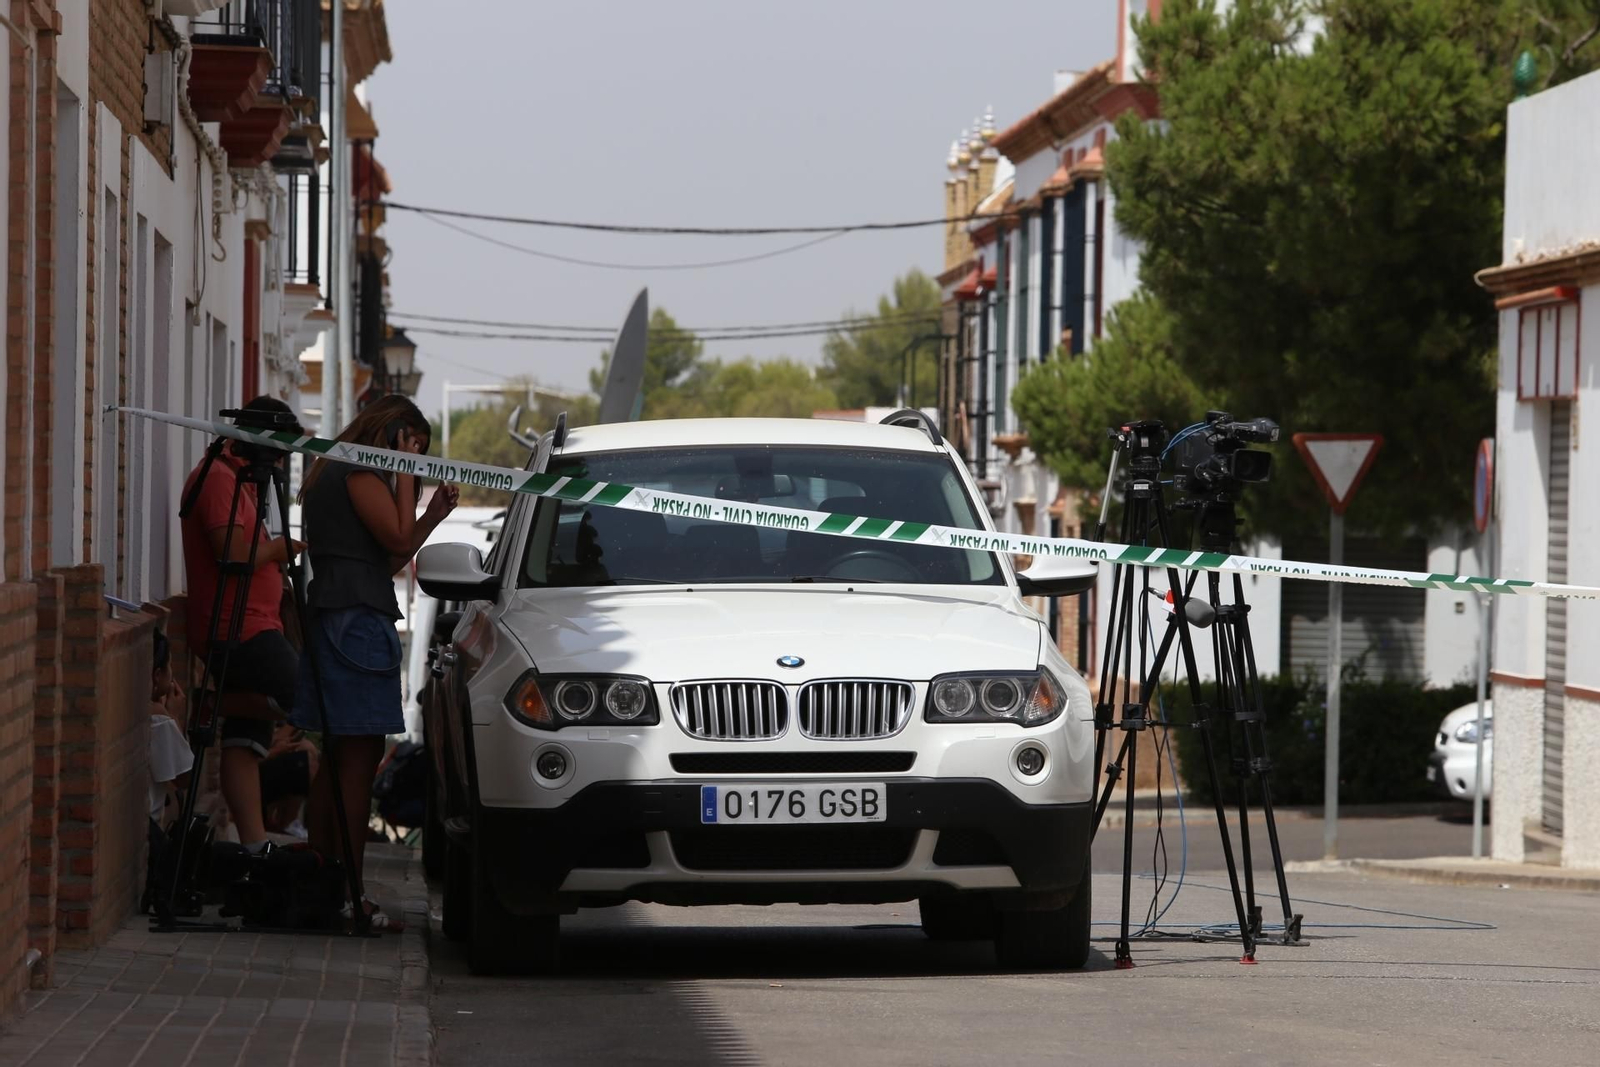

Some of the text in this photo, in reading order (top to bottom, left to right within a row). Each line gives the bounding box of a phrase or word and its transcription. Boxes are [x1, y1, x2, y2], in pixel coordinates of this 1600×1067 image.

[357, 451, 396, 470] PASAR
[398, 458, 416, 474] NO
[427, 463, 456, 481] CIVIL
[460, 467, 513, 490] GUARDIA
[652, 496, 691, 516] PASAR
[693, 503, 712, 519] NO
[723, 506, 752, 524] CIVIL
[756, 510, 809, 530] GUARDIA
[950, 534, 988, 549] PASAR
[1020, 541, 1050, 555] CIVIL
[1053, 544, 1108, 559] GUARDIA
[706, 808, 713, 816] E
[724, 788, 879, 819] 0176 GSB
